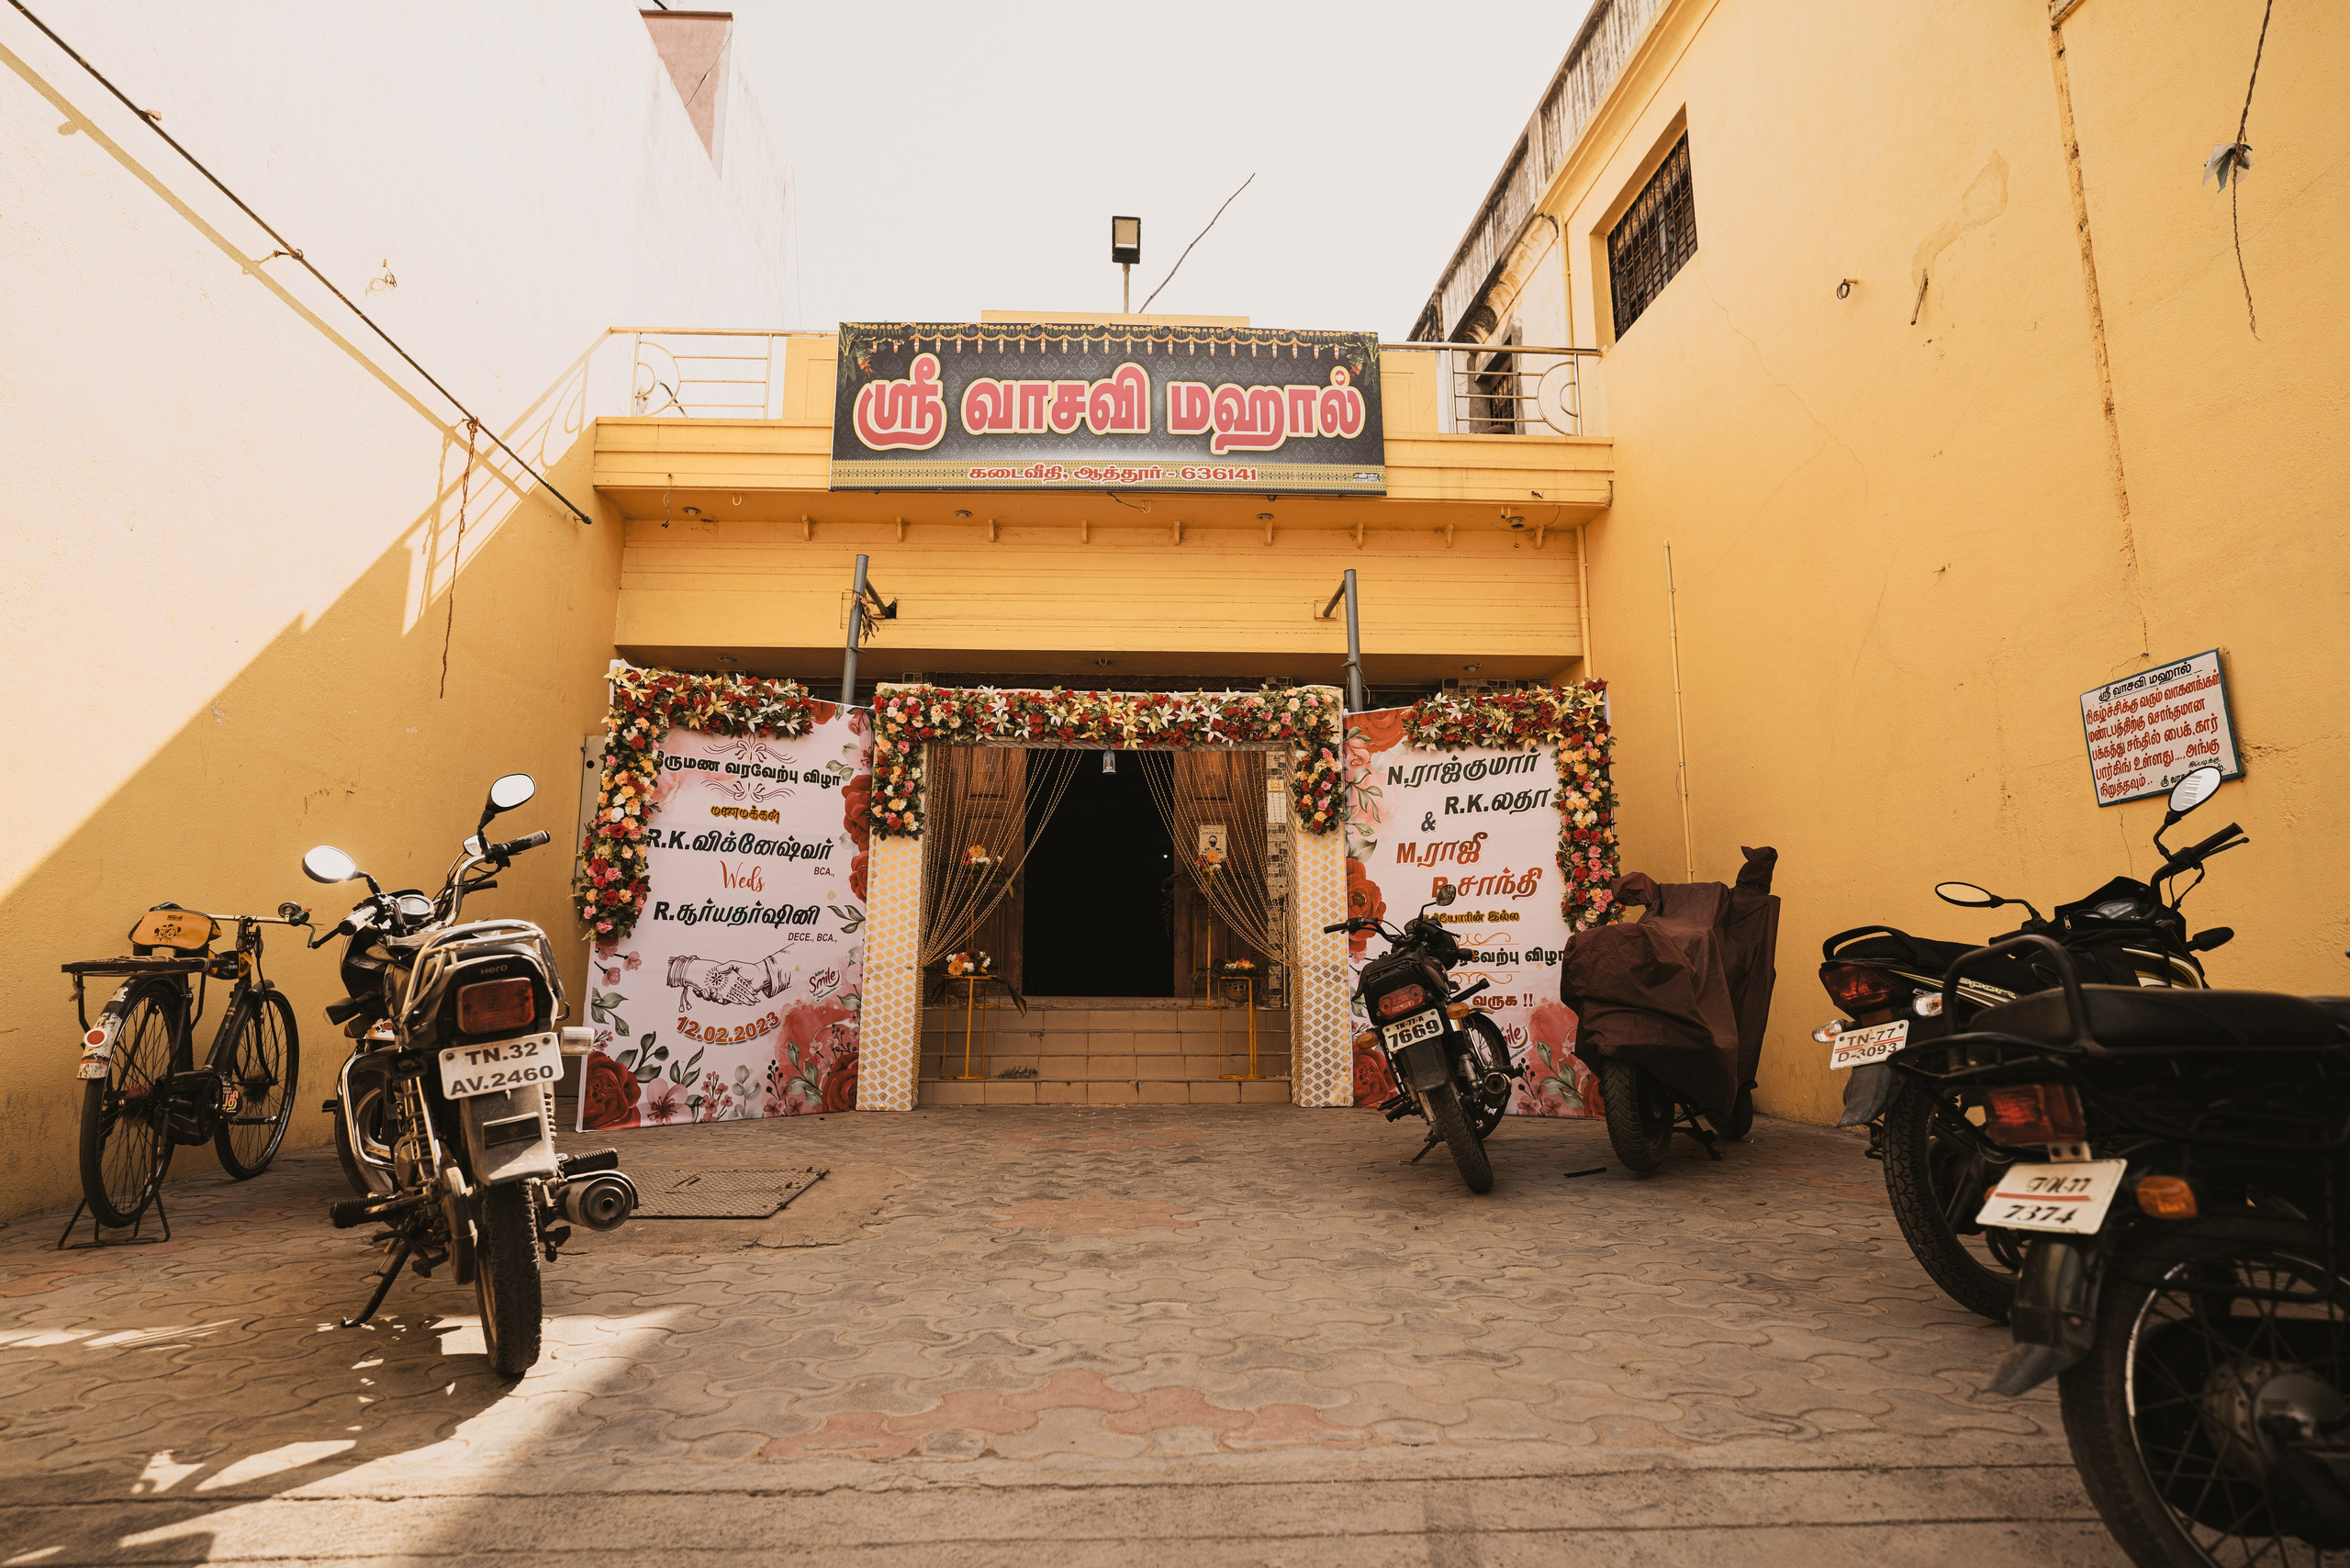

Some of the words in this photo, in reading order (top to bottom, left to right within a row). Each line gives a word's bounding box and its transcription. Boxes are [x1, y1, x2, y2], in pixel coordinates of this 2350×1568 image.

[855, 353, 947, 451] ஸ்ரீ
[962, 363, 1150, 434] வாசவி
[1167, 366, 1366, 454] மஹால்
[968, 464, 1069, 483] கடைவீதி,
[1073, 465, 1162, 484] ஆத்தூர்
[1181, 466, 1258, 481] 636141
[2113, 677, 2147, 696] வாசவி
[2149, 662, 2191, 685] மஹால்
[2086, 698, 2138, 724] நிகழ்ச்சிக்கு
[2140, 688, 2163, 708] வரும்
[2165, 669, 2221, 700] வாகனங்கள்
[2087, 712, 2145, 744] மண்டபத்திற்கு
[2148, 698, 2205, 727] சொந்தமான
[2092, 740, 2126, 762] பக்கத்து
[2127, 728, 2161, 753] சந்தில்
[725, 762, 798, 783] வரவேற்பு
[803, 769, 841, 789] விழா
[1387, 747, 1541, 789] N.ராஜ்குமார்
[2096, 757, 2132, 781] பார்கிங்
[711, 805, 780, 824] மணமக்கள்
[1444, 788, 1551, 815] R.K.லதா
[1420, 811, 1437, 833] &
[647, 829, 834, 862] R.K.விக்னேஷ்வர்
[720, 860, 766, 892] Weds
[654, 898, 821, 929] R.சூர்யதர்ஷினி
[1487, 909, 1520, 922] இல்ல
[480, 964, 508, 975] Hero
[809, 967, 836, 993] Smile
[1472, 993, 1517, 1010] வருக
[1958, 977, 2017, 999] sport
[677, 1011, 779, 1043] 12.02.2023
[1388, 1019, 1439, 1047] 7669
[1395, 1015, 1425, 1030] TN-77-A
[1847, 1028, 1896, 1047] TN-77
[464, 1042, 538, 1066] TN.32
[450, 1065, 554, 1095] AV.2460
[2002, 1204, 2078, 1225] 7374
